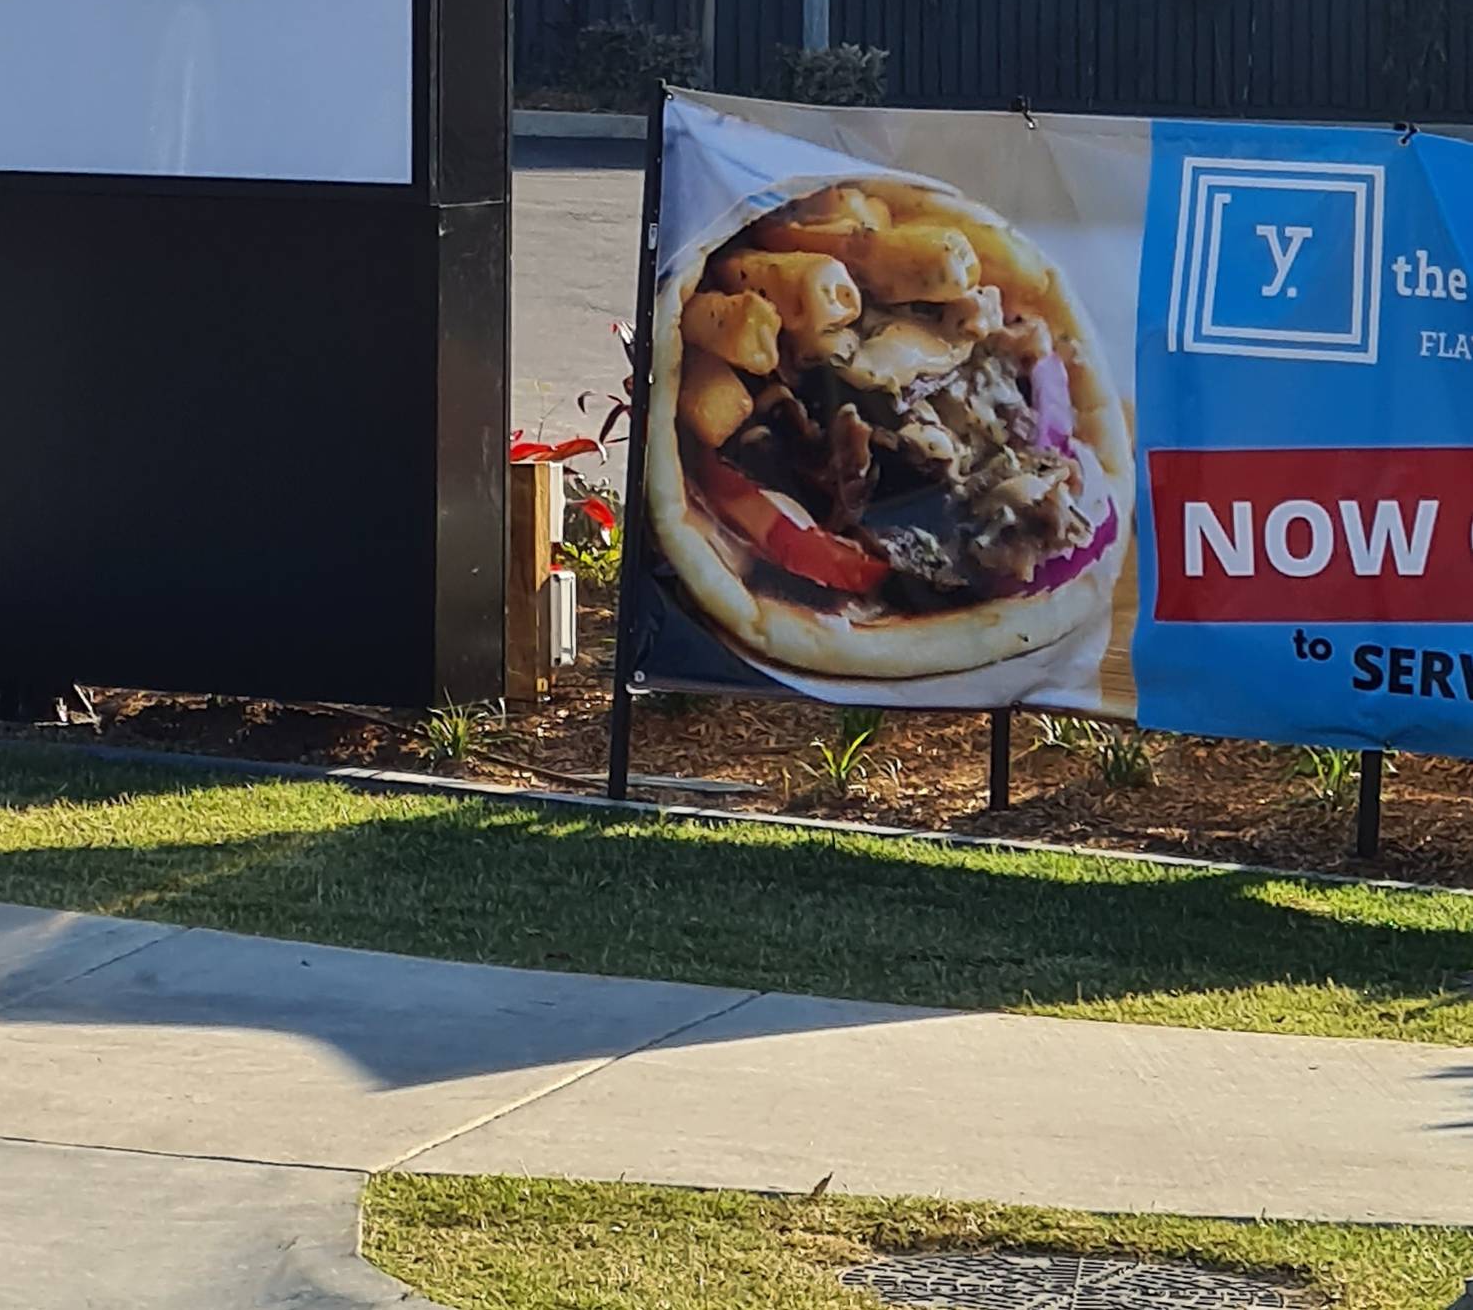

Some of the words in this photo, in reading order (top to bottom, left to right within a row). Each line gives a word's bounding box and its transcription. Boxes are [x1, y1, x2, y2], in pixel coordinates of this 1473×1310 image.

[1391, 249, 1467, 301] the
[1419, 330, 1472, 360] FLA
[1184, 499, 1440, 577] NOW
[1293, 628, 1333, 661] to
